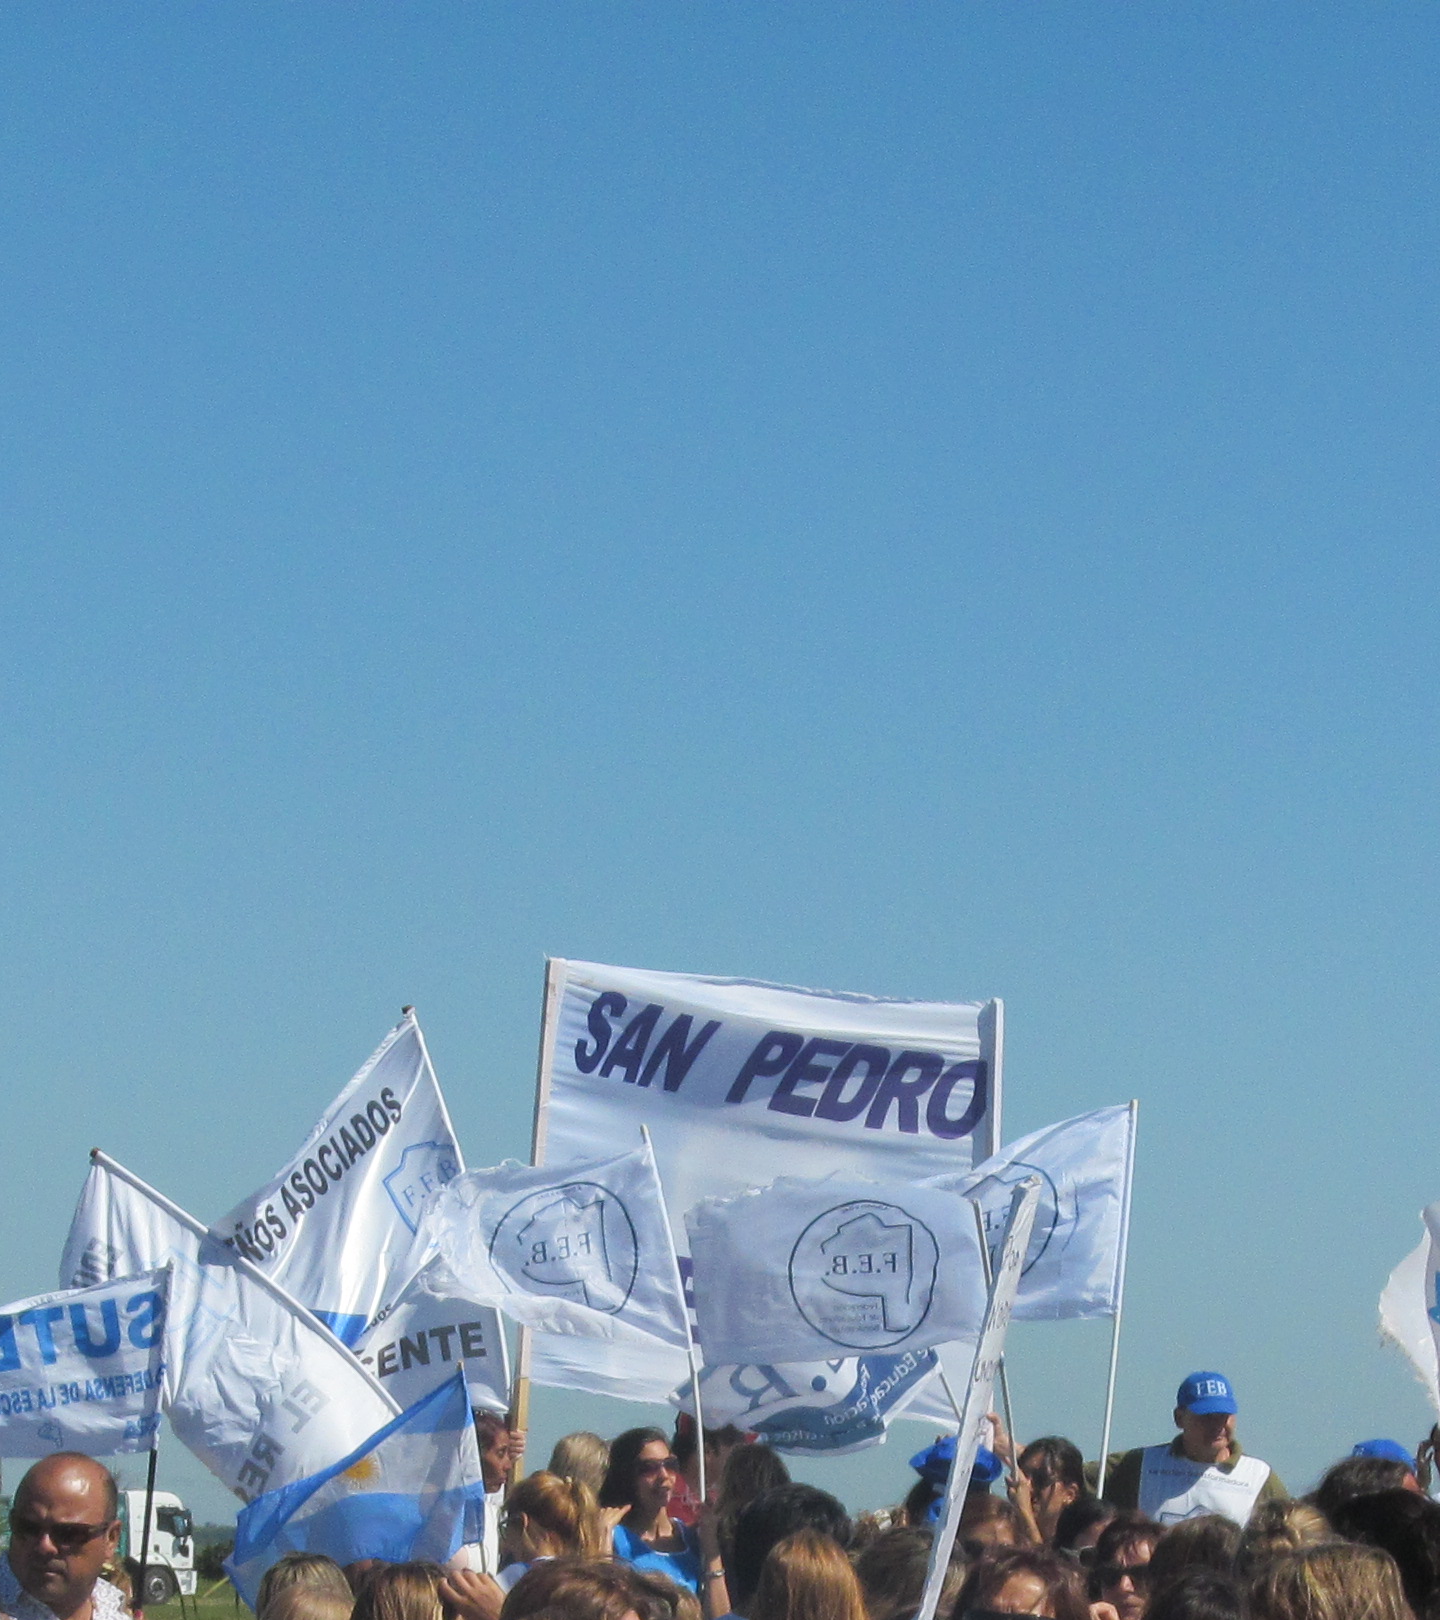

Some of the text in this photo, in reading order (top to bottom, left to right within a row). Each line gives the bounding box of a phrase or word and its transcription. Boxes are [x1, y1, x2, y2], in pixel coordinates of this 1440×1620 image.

[573, 990, 989, 1140] SAN PEDRO
[279, 1086, 402, 1225] ASOCIADOS
[1195, 1379, 1228, 1397] FEB
